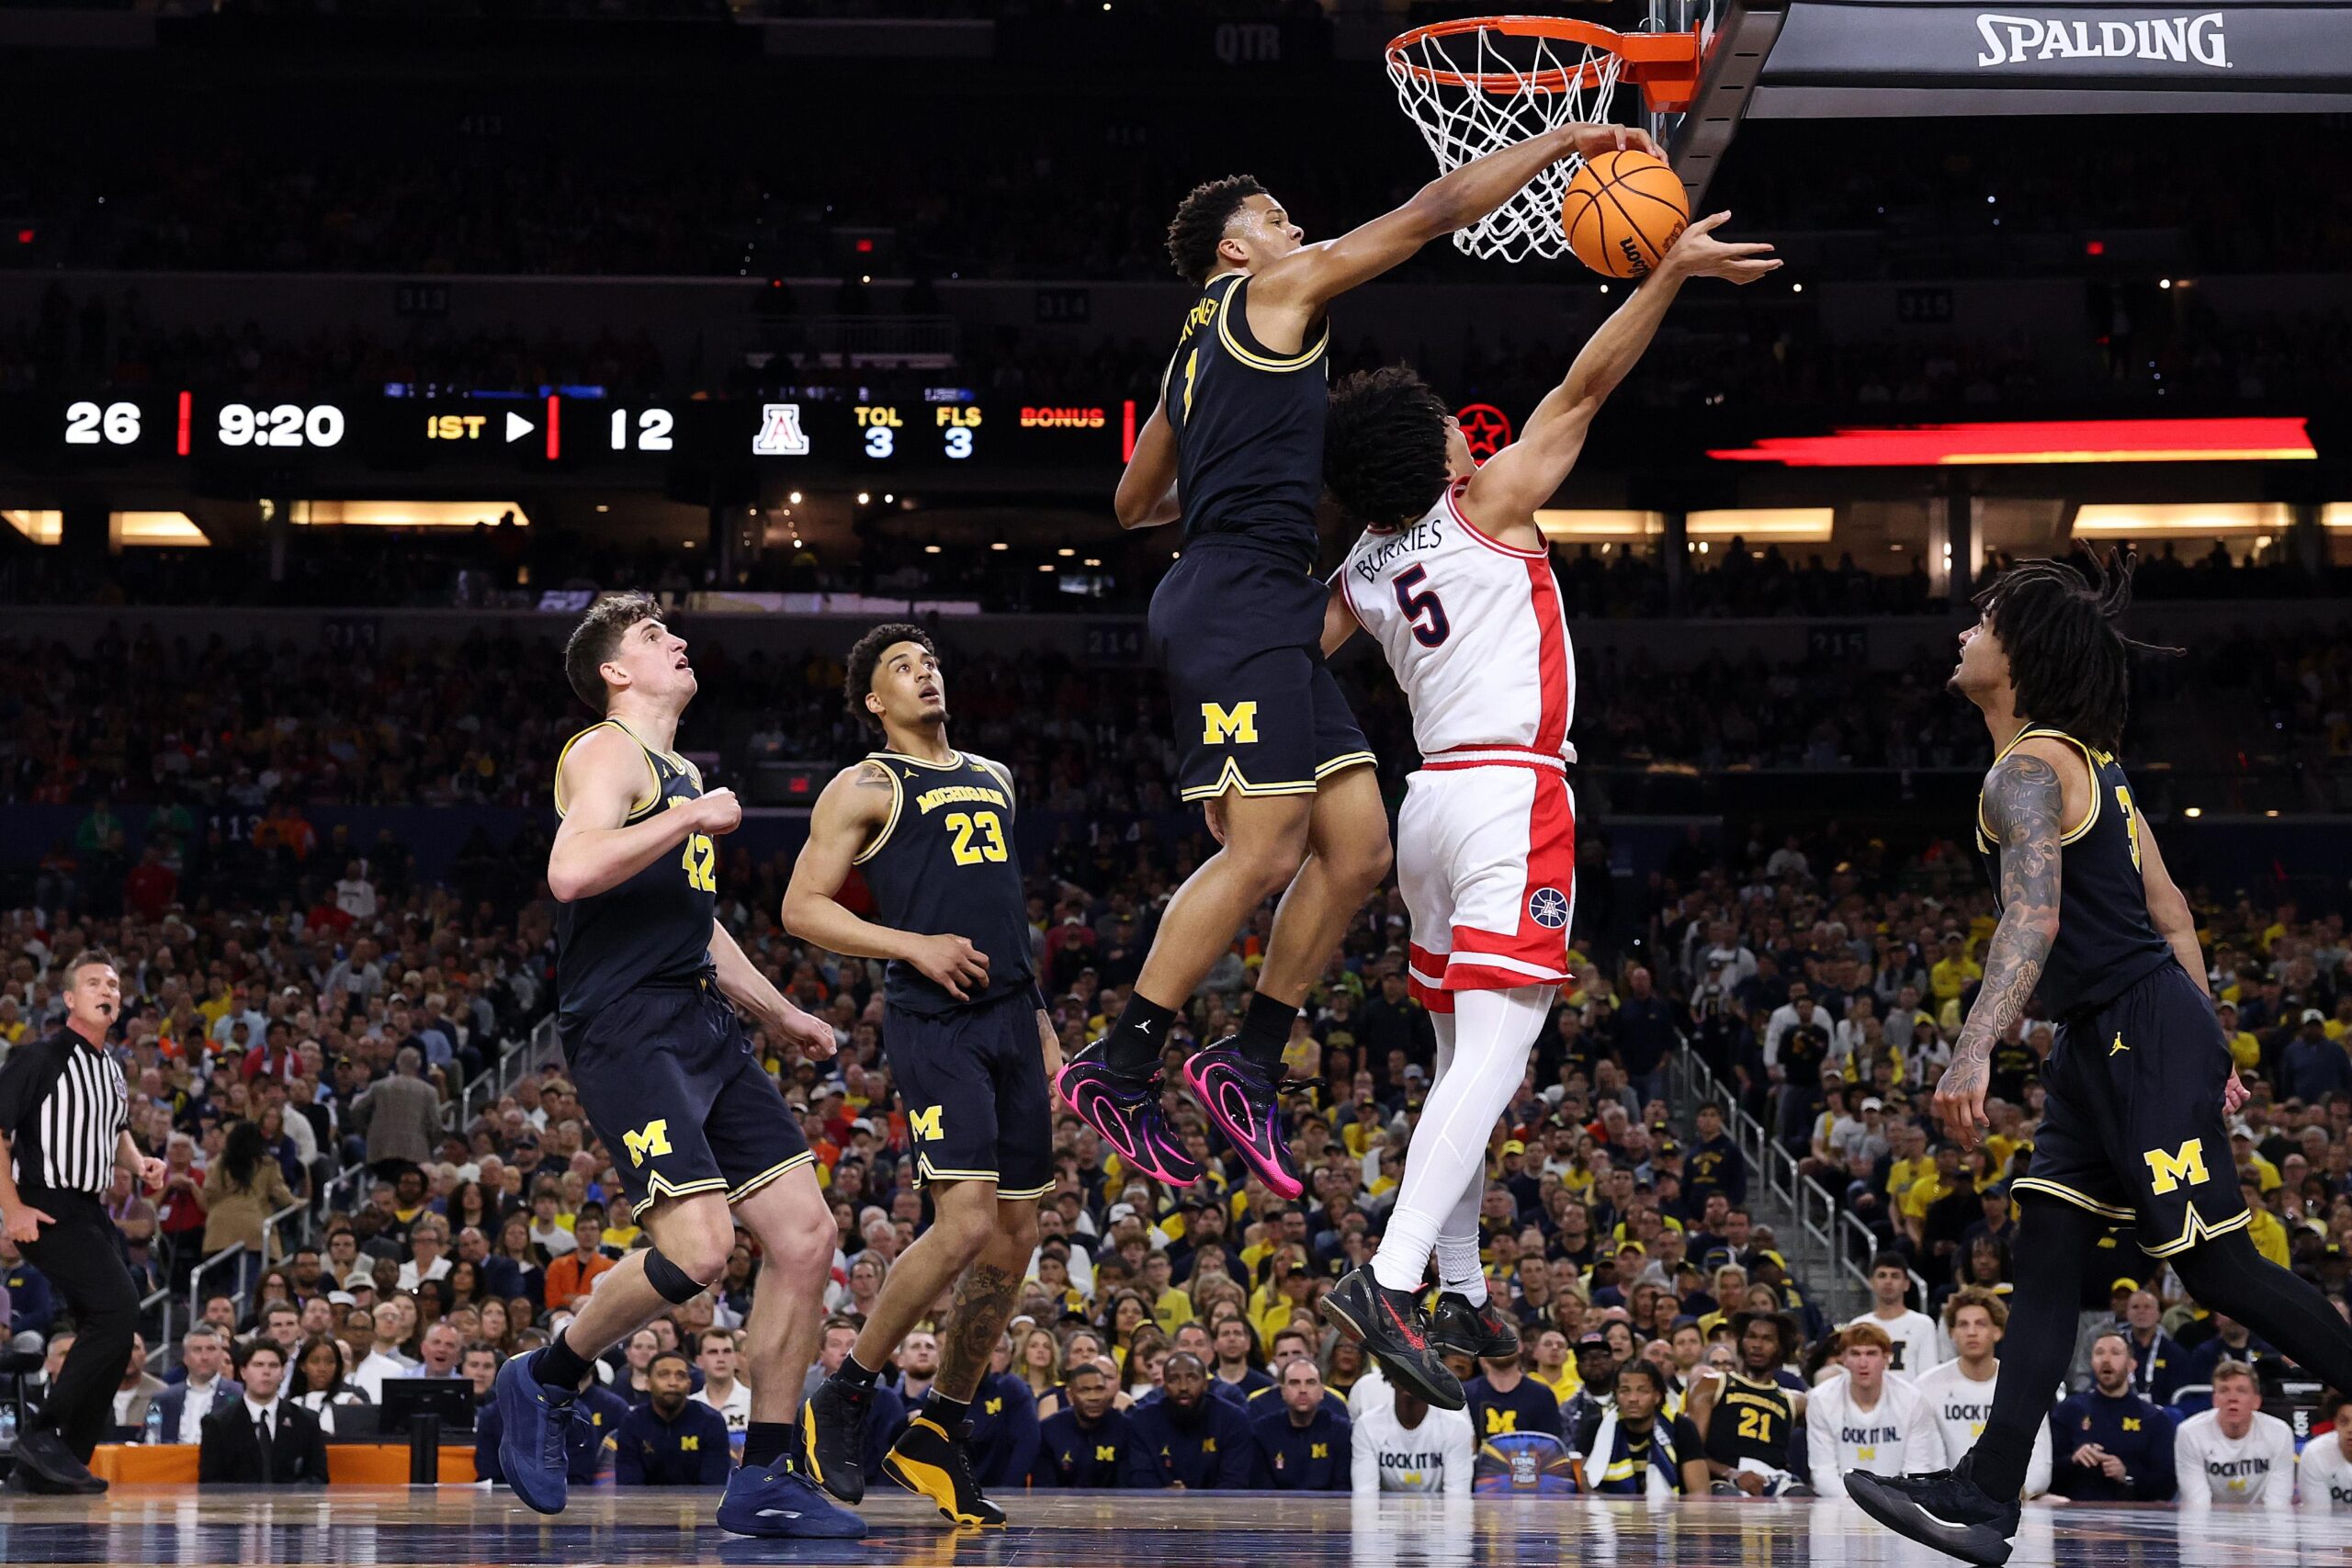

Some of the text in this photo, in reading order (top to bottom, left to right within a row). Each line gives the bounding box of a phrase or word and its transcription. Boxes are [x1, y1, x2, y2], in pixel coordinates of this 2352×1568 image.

[1215, 23, 1282, 63] QTR
[1976, 12, 2227, 67] SPALDING
[1183, 346, 1199, 427] 1
[65, 401, 141, 445] 26
[219, 404, 345, 447] 9:20
[611, 408, 674, 450] 12
[752, 404, 809, 455] A
[854, 407, 903, 427] TOL
[936, 407, 982, 427] FLS
[1020, 408, 1105, 428] BONUS
[865, 427, 894, 458] 3
[944, 427, 973, 458] 3
[1355, 519, 1442, 583] BURRIES
[1392, 562, 1451, 648] 5
[1089, 630, 1139, 653] 214
[1201, 701, 1259, 745] M
[916, 785, 1008, 815] MICHIGAN
[944, 811, 1009, 866] 23
[1088, 821, 1141, 847] 14
[2115, 785, 2142, 874] 3
[683, 830, 717, 894] 42
[909, 1104, 944, 1143] M
[622, 1118, 673, 1168] M
[2143, 1137, 2211, 1196] M
[729, 1415, 744, 1426] M
[985, 1396, 1003, 1415] M
[1486, 1407, 1518, 1434] M
[1945, 1404, 1982, 1420] LOCK
[1737, 1406, 1771, 1443] 21
[1842, 1427, 1867, 1443] OCK
[2122, 1416, 2142, 1431] M
[681, 1435, 699, 1451] M
[1096, 1445, 1115, 1461] M
[1311, 1443, 1329, 1459] M
[1379, 1451, 1413, 1469] LOCK
[1416, 1452, 1428, 1469] IT
